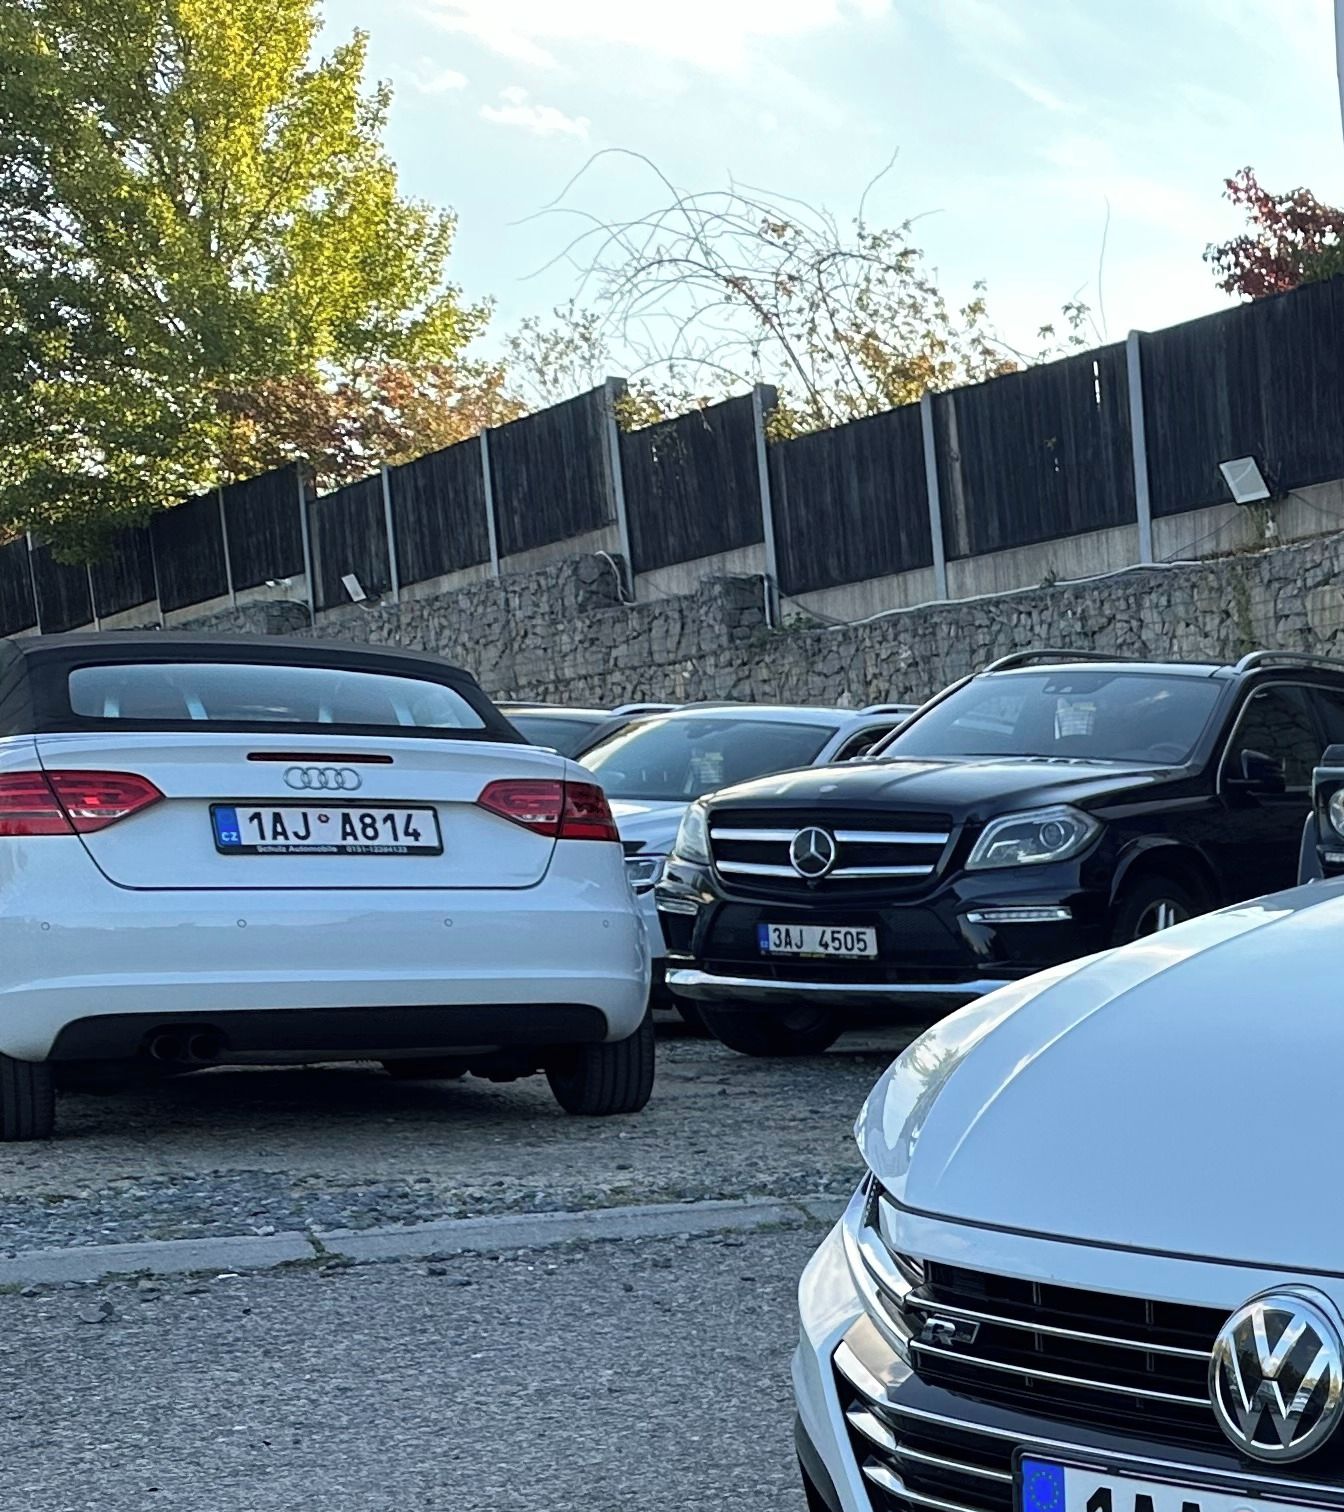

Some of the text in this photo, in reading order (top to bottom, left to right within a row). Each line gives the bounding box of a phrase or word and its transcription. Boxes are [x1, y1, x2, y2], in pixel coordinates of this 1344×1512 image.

[221, 831, 239, 841] CZ
[248, 812, 421, 842] 1AJ A814
[773, 927, 867, 952] 3AJ 4505
